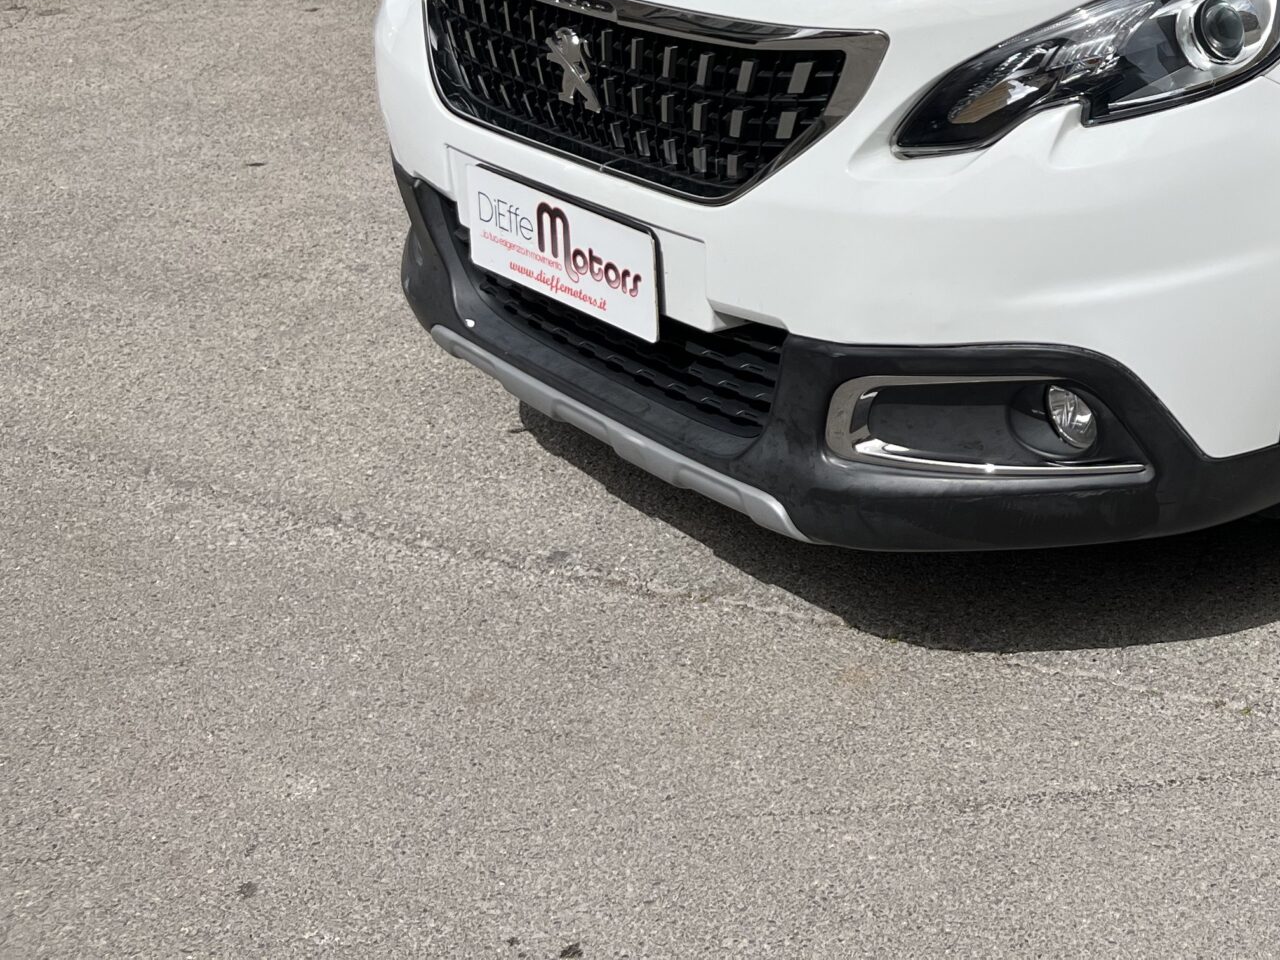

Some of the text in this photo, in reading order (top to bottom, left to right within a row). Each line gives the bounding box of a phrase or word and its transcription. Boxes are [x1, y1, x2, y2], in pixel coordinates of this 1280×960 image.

[477, 191, 642, 298] DiEffe Motors
[509, 261, 607, 311] www.dieffemotors.it
